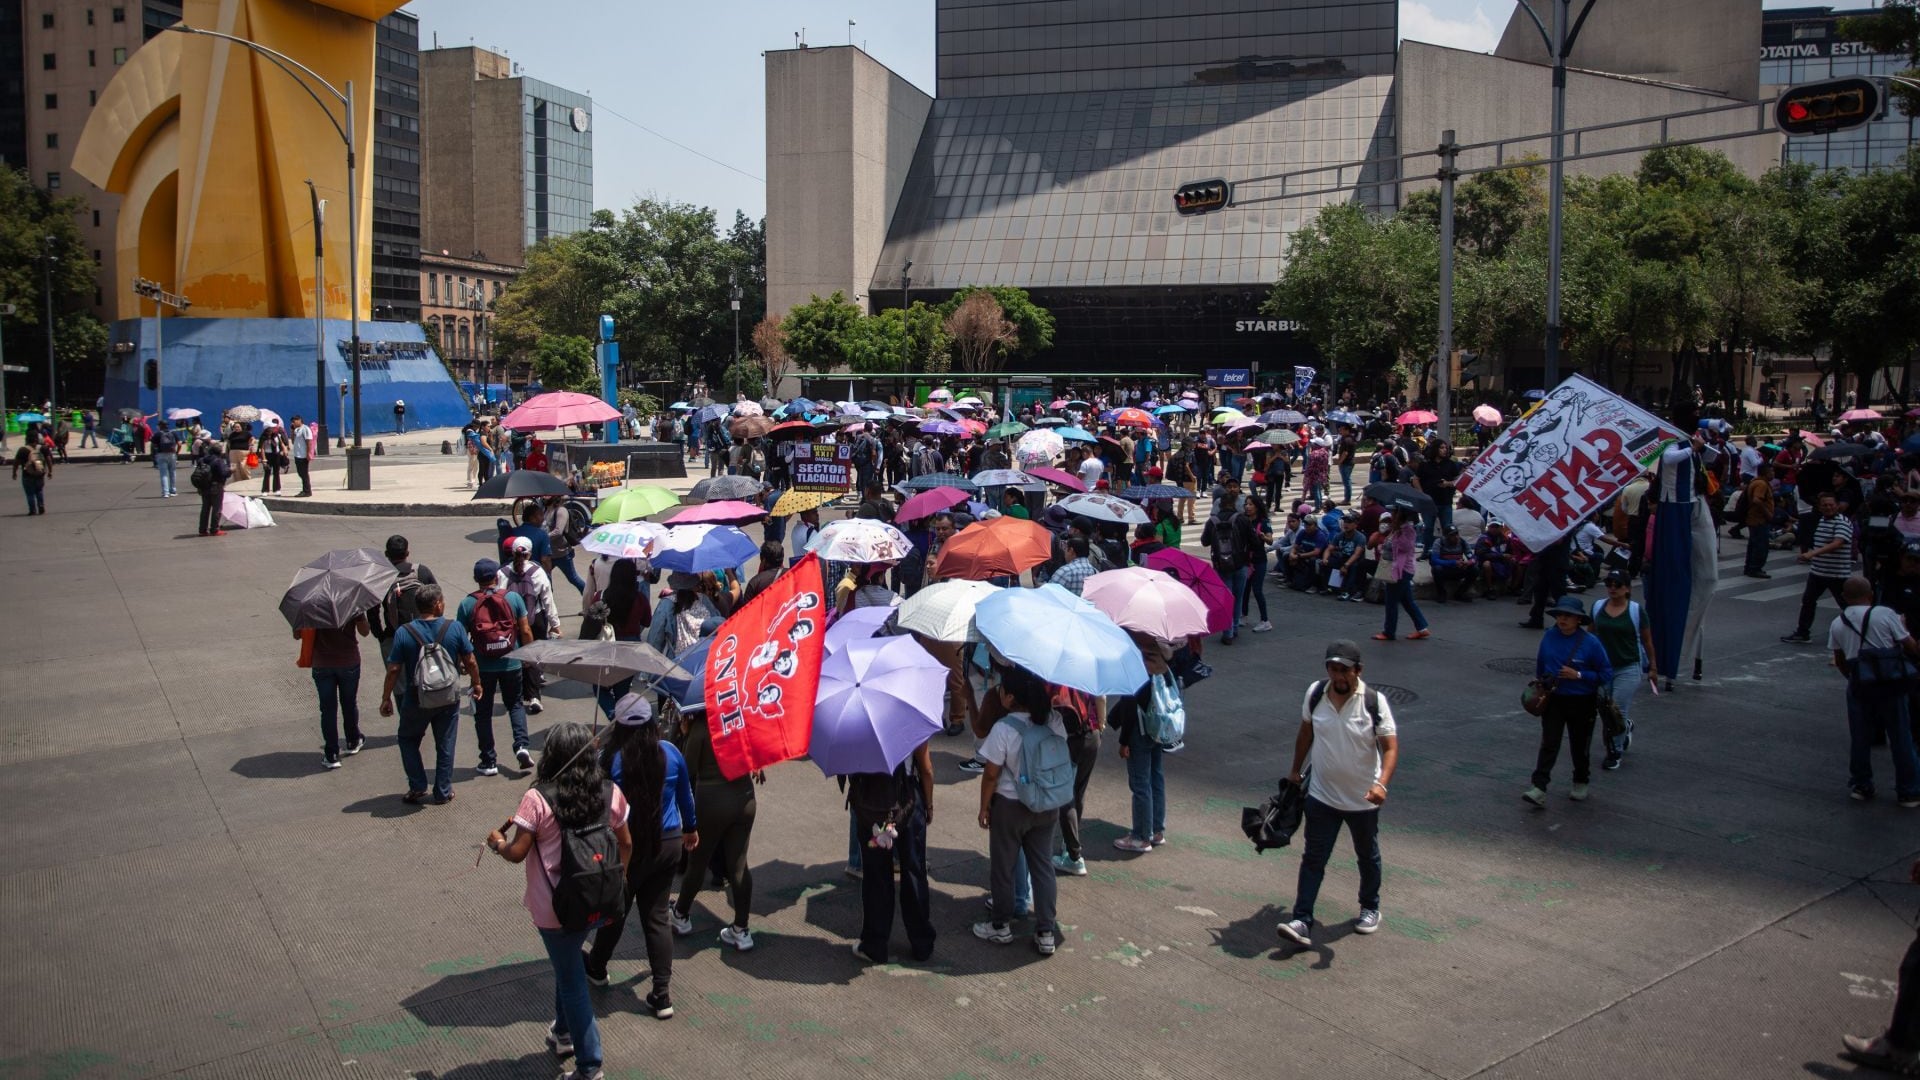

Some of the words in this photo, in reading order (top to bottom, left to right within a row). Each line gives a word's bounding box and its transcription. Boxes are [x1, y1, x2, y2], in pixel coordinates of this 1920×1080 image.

[1831, 41, 1877, 55] ESTU
[1235, 320, 1309, 332] STARBU
[1223, 373, 1245, 382] telcel
[798, 464, 846, 474] SECTOR
[796, 474, 847, 484] TLACOLULA
[486, 640, 508, 651] PUMA
[714, 633, 745, 736] CNTE
